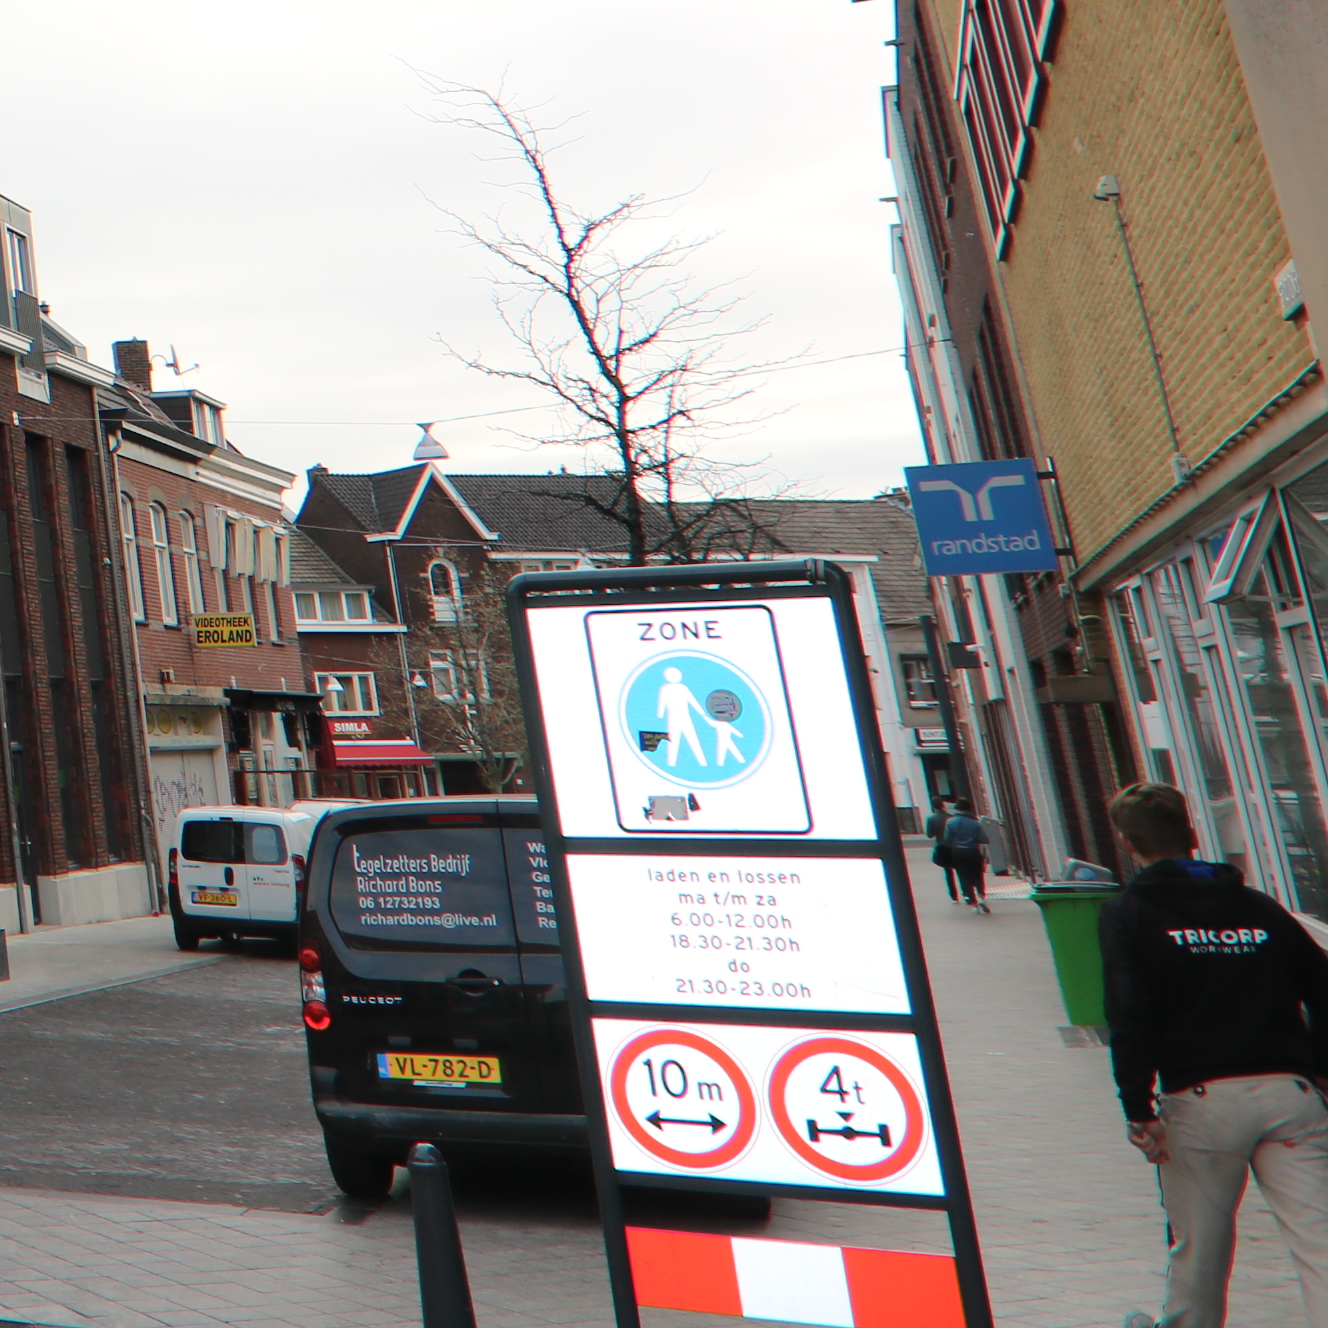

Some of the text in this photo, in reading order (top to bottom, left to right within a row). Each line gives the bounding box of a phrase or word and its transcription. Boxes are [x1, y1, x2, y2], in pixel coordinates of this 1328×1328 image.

[931, 529, 1041, 555] randstad
[194, 617, 250, 628] VIDEOTHEEK
[637, 620, 723, 641] ZONE
[197, 629, 253, 644] EROLAND
[334, 722, 370, 732] SIMLA
[430, 854, 470, 876] Bedrijf
[357, 876, 443, 893] Richard Bons
[647, 869, 801, 884] laden en lossen
[359, 897, 440, 909] 06 12732193
[678, 891, 777, 906] ma t/m za
[360, 913, 497, 928] richardbons@live.nl
[671, 912, 792, 929] 6.00-12.00h
[670, 934, 800, 952] 18.30-21.30h
[1168, 929, 1268, 945] TRICORP
[728, 959, 750, 973] do
[676, 978, 812, 998] 21.30-23.00h
[395, 1057, 492, 1079] VL-782-D
[643, 1058, 724, 1102] 10 m
[820, 1064, 866, 1104] 4 t
